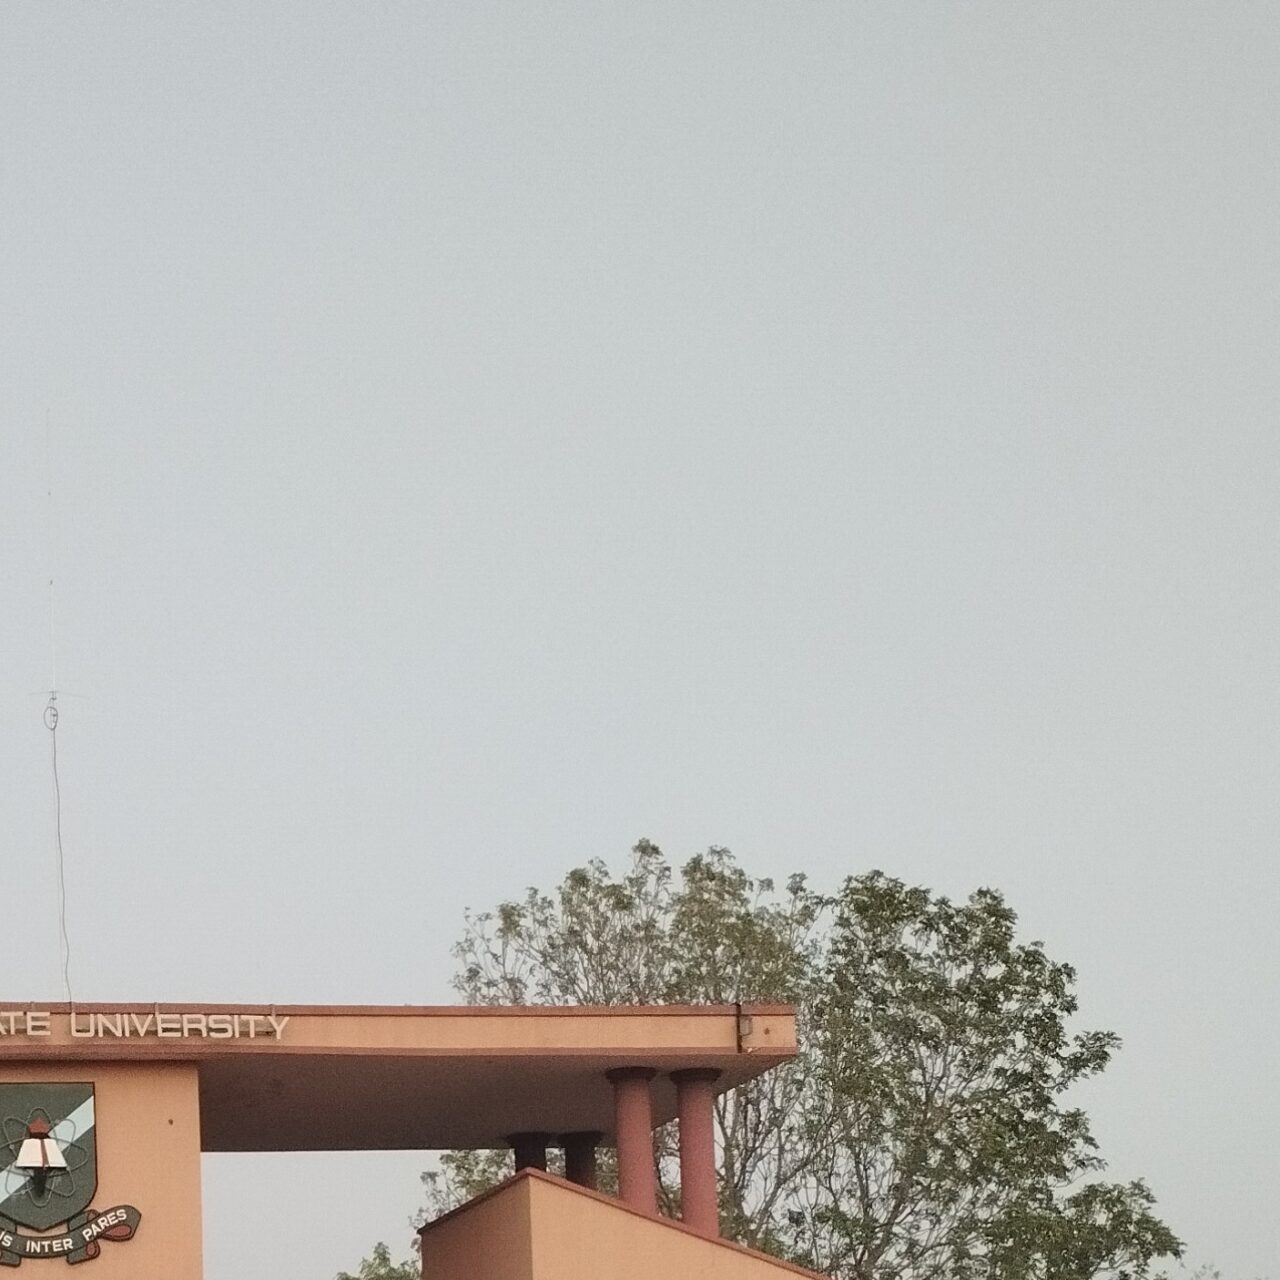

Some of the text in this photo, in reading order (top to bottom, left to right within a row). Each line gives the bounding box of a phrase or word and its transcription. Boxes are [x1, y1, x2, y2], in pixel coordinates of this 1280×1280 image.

[70, 1012, 290, 1041] UNIVERSITY
[25, 1237, 74, 1254] INTER
[81, 1208, 128, 1242] PARES
